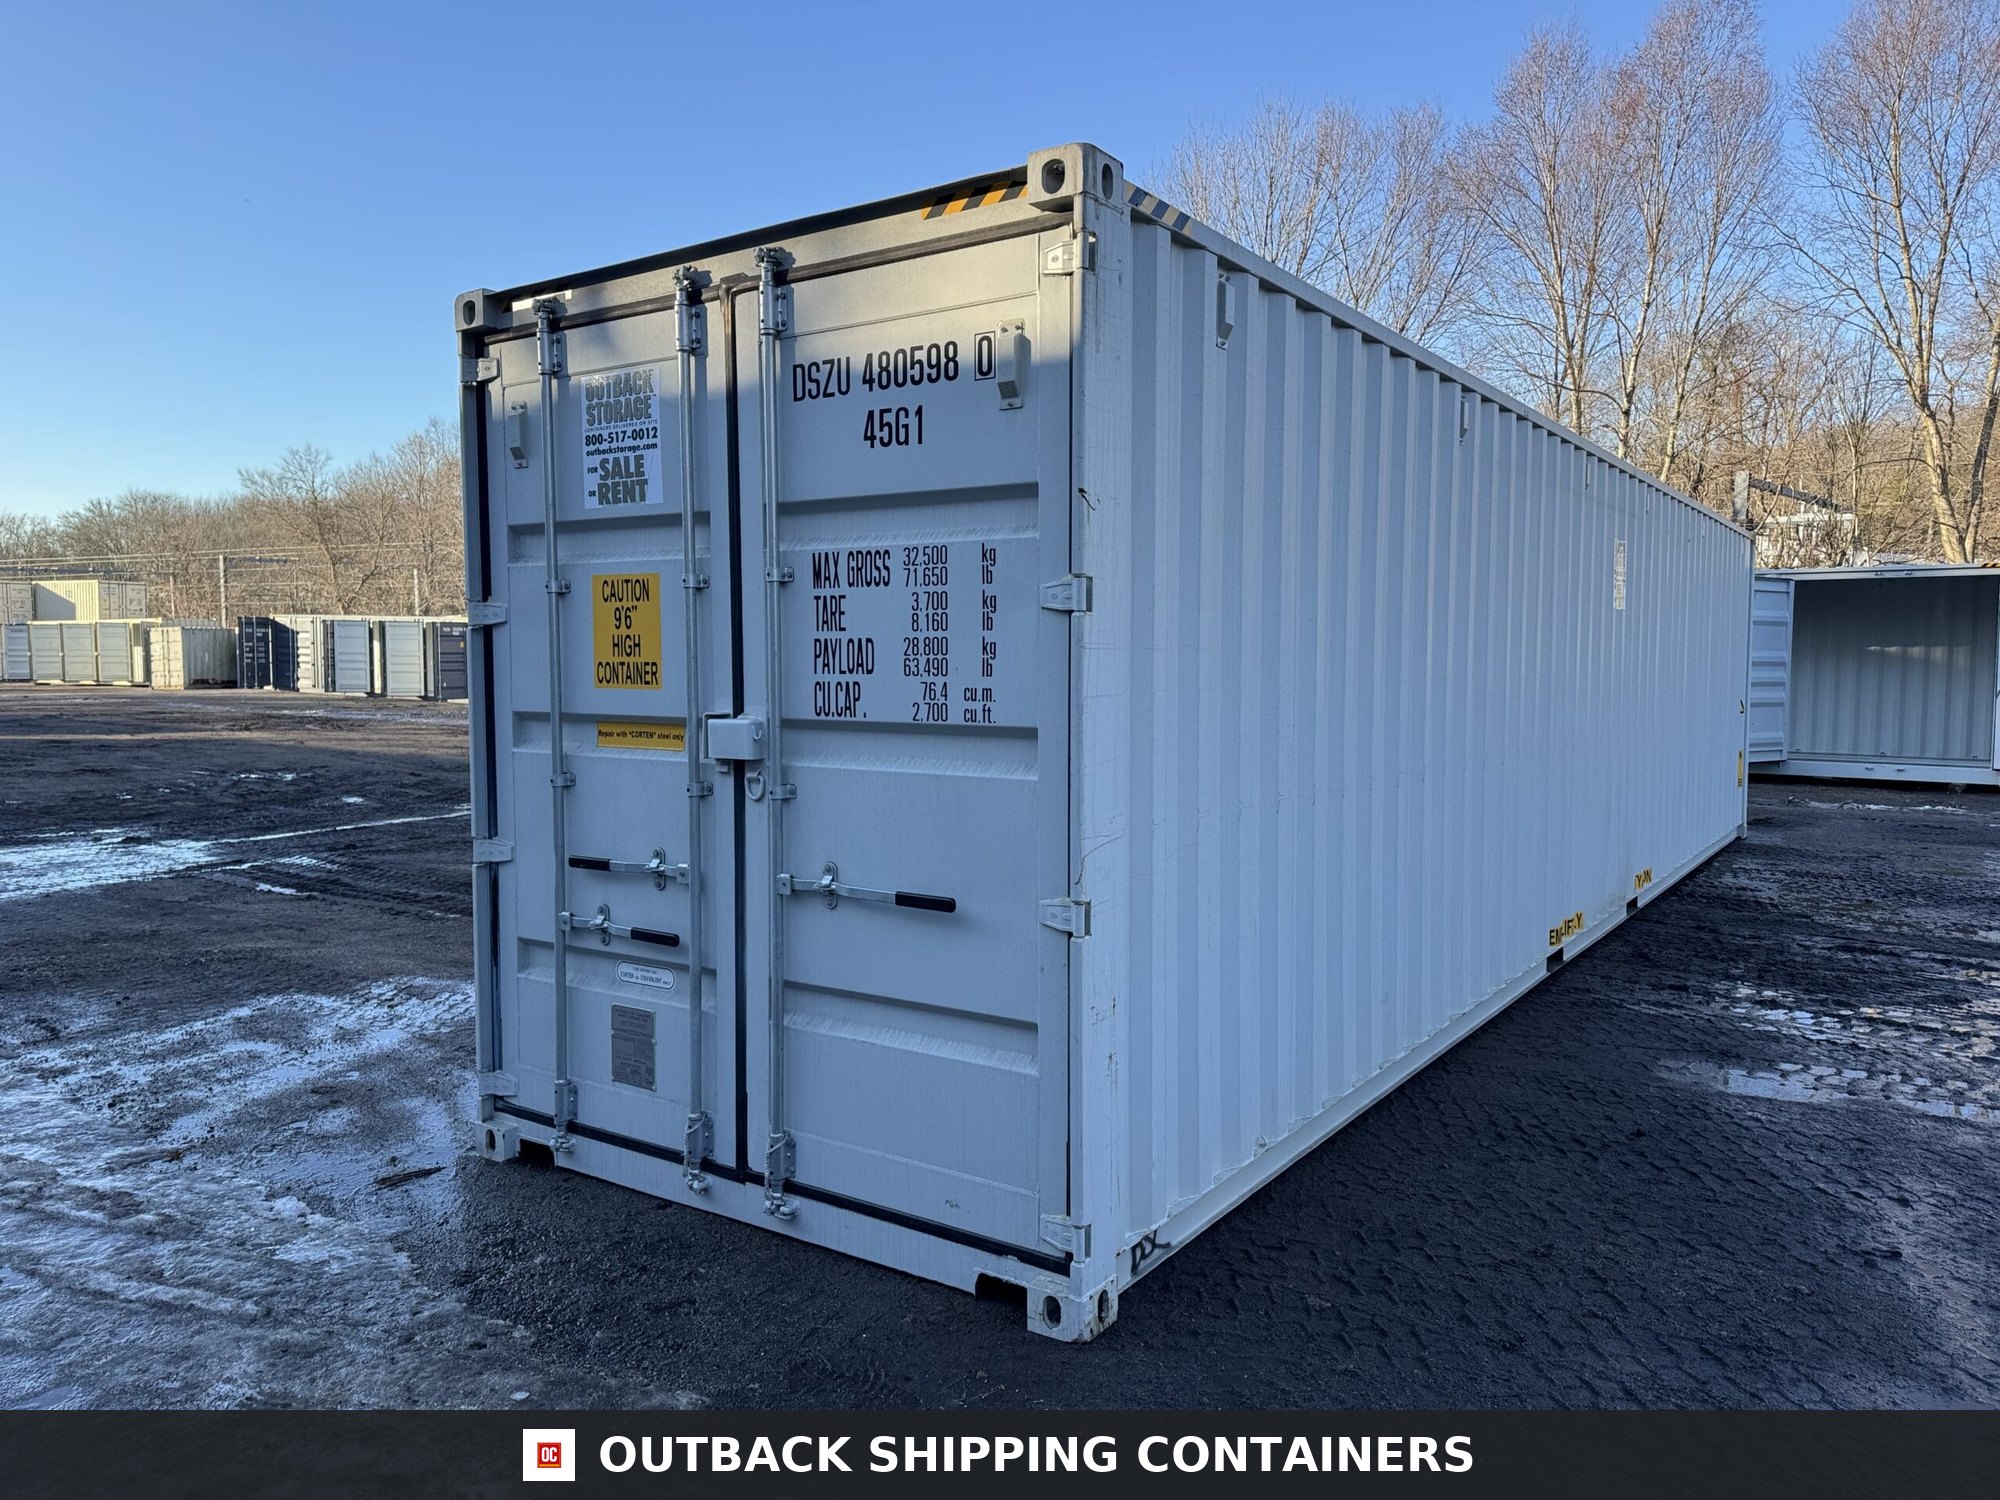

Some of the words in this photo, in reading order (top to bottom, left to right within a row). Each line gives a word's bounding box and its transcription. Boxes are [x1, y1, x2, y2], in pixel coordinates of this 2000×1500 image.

[792, 356, 850, 402] DSZU
[862, 340, 959, 392] 480598
[977, 335, 993, 377] 0
[585, 369, 654, 402] OUTBACK
[586, 395, 652, 427] STORAGE
[585, 426, 658, 446] 800-517-0012
[863, 405, 923, 449] 45G1
[586, 443, 658, 456] outbackstorage.com
[587, 466, 598, 474] FOR
[599, 454, 645, 481] SALE
[597, 478, 648, 506] RENT
[903, 545, 948, 567] 32,500
[981, 543, 996, 567] kg
[812, 551, 840, 589] MAX
[847, 549, 891, 588] GROSS
[903, 566, 948, 588] 71,650
[982, 564, 993, 584] lb
[602, 578, 650, 603] CAUTION
[911, 591, 948, 612] 3,700
[982, 590, 997, 613] kg
[813, 594, 846, 632] TARE
[911, 612, 948, 633] 8,160
[982, 611, 993, 631] lb
[612, 634, 641, 657] HIGH
[814, 638, 875, 675] PAYLOAD
[903, 636, 948, 657] 28,800
[982, 636, 997, 660] kg
[597, 661, 659, 685] CONTAINER
[903, 657, 948, 678] 63,490
[982, 658, 993, 677] lb
[920, 682, 948, 701] 76.4
[963, 687, 997, 703] cu.m.
[912, 702, 948, 722] 2,700
[963, 703, 997, 724] cu.ft.
[598, 729, 615, 739] Repair
[657, 732, 671, 740] steel
[672, 733, 684, 742] only
